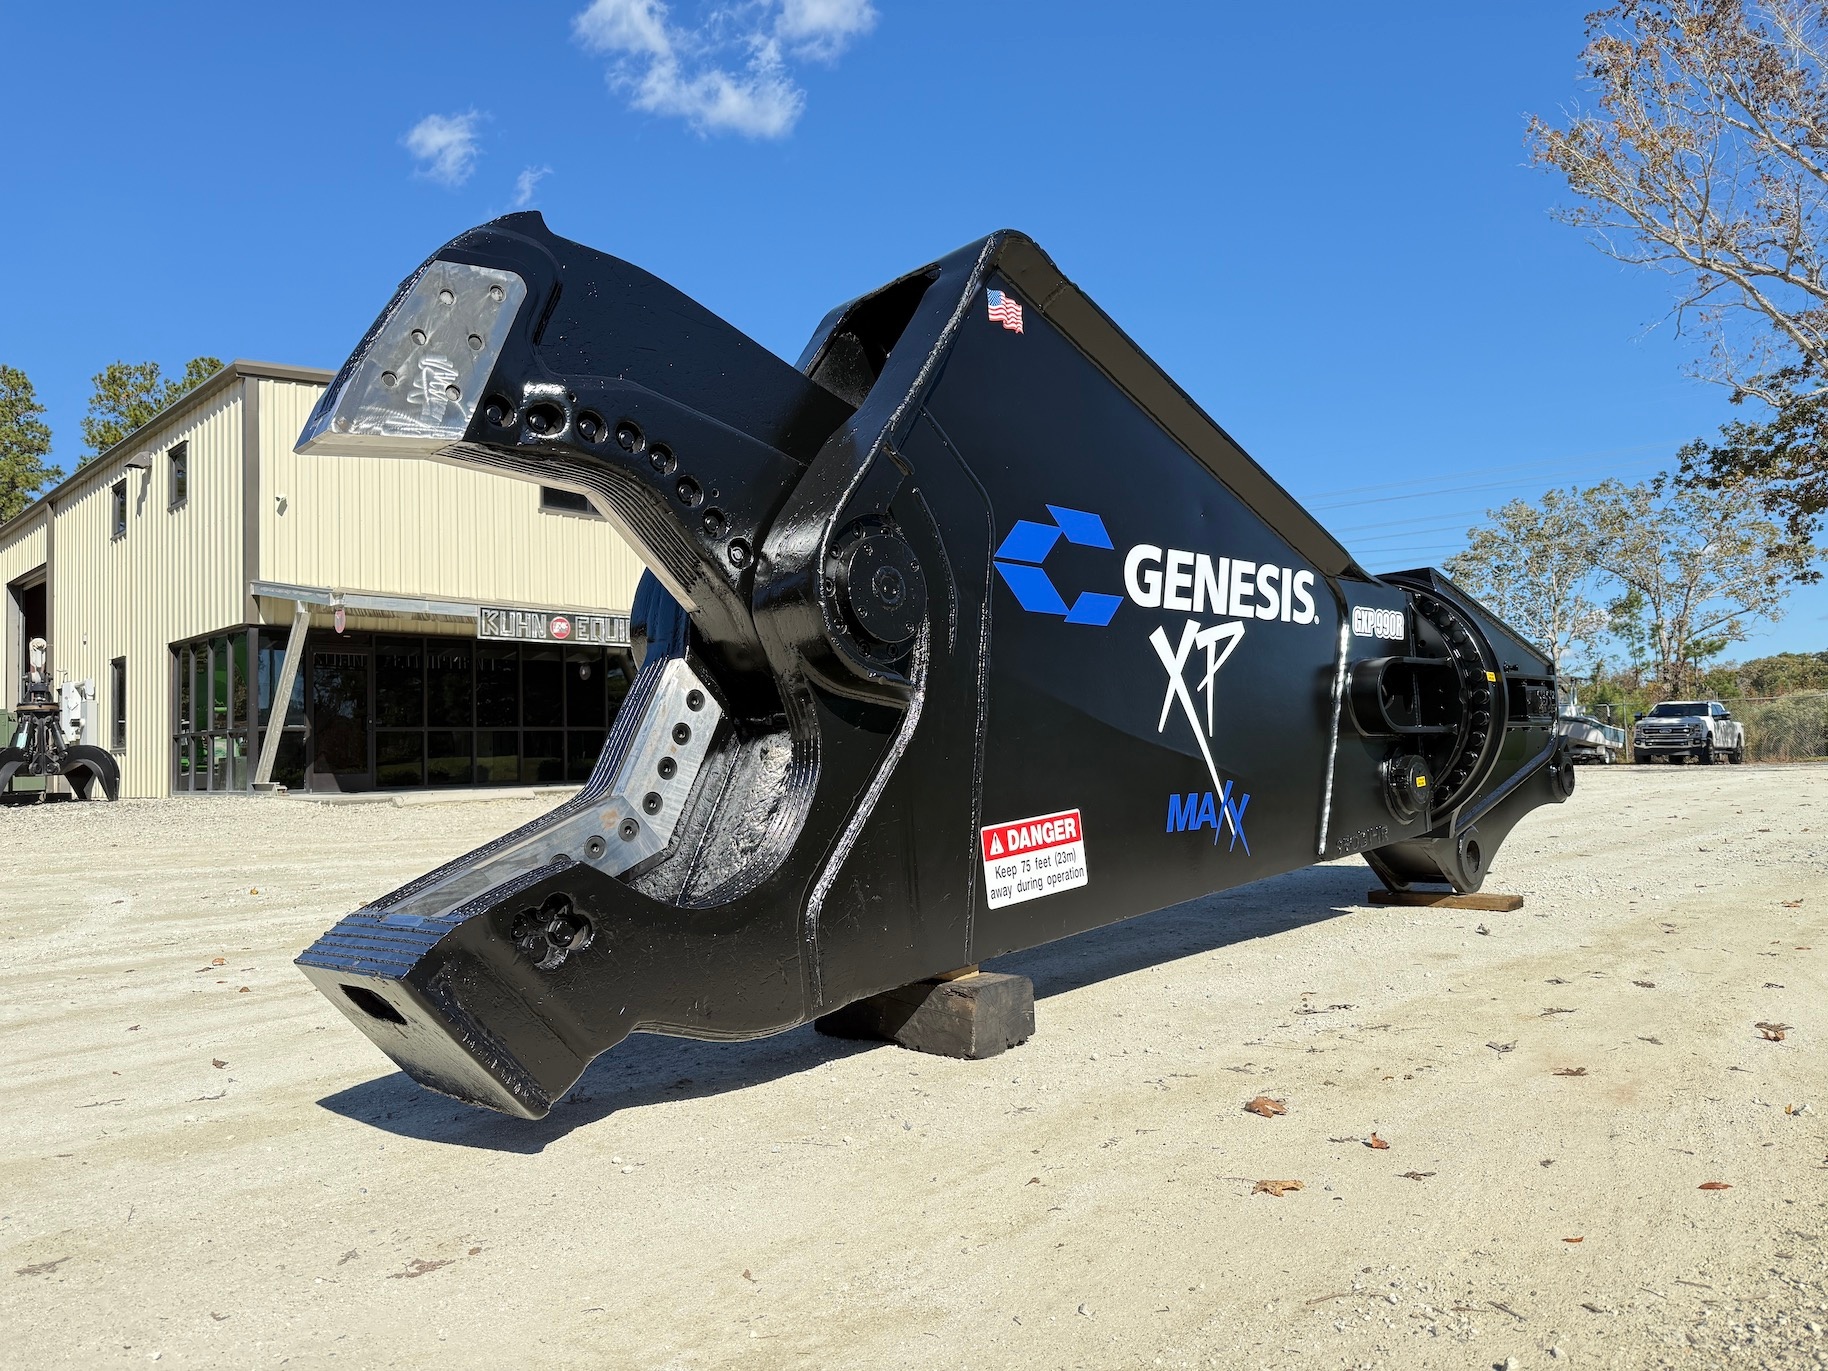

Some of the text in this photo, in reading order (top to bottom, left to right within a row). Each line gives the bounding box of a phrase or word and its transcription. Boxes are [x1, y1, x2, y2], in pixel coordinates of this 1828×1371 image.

[1123, 543, 1315, 625] GENESIS
[481, 608, 547, 639] KUHN
[1353, 608, 1403, 639] GXP 990R
[1007, 817, 1077, 852] DANGER
[995, 848, 1077, 880] Keep 75 feet (23m)
[990, 866, 1085, 900] away during operation
